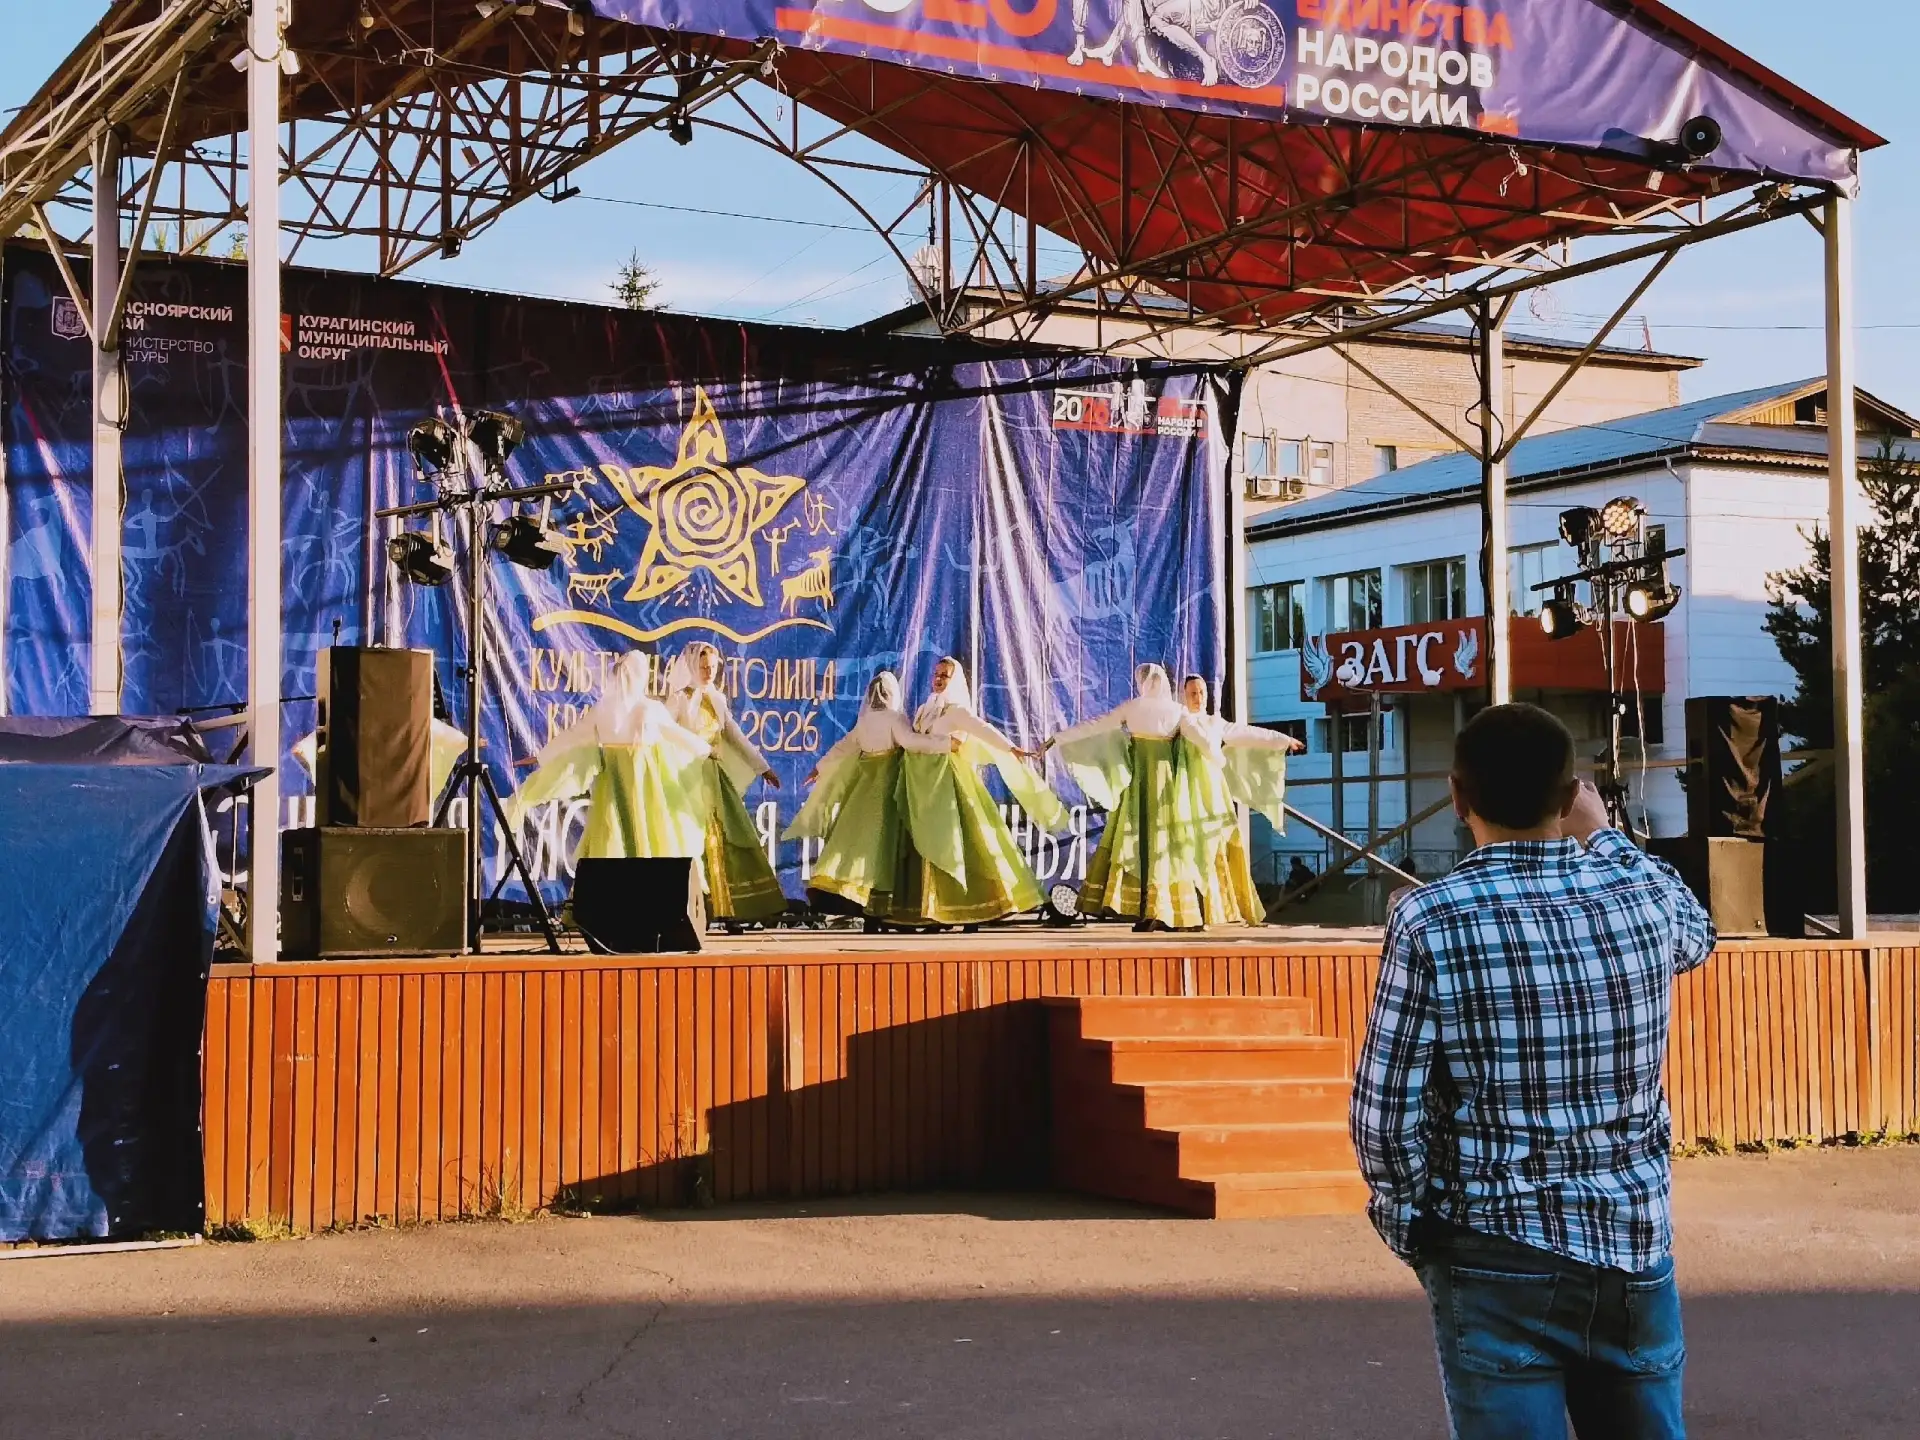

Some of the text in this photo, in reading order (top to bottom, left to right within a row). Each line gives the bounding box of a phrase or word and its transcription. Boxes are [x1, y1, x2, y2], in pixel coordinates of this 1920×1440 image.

[1297, 27, 1494, 89] НАРОДОВ
[1296, 73, 1470, 128] РОССИИ
[122, 301, 233, 322] АСНОЯРСКИЙ
[299, 314, 415, 336] КУРАГИНСКИЙ
[125, 336, 214, 354] НИСТЕРСТВО
[298, 330, 449, 355] МУНИЦИПАЛЬНЫЙ
[298, 345, 351, 361] ОКРУГ
[125, 350, 169, 364] ЬТУРЫ
[1336, 632, 1445, 687] ЗАГС
[719, 656, 835, 706] ТОЛИЦА
[741, 710, 819, 752] 2026
